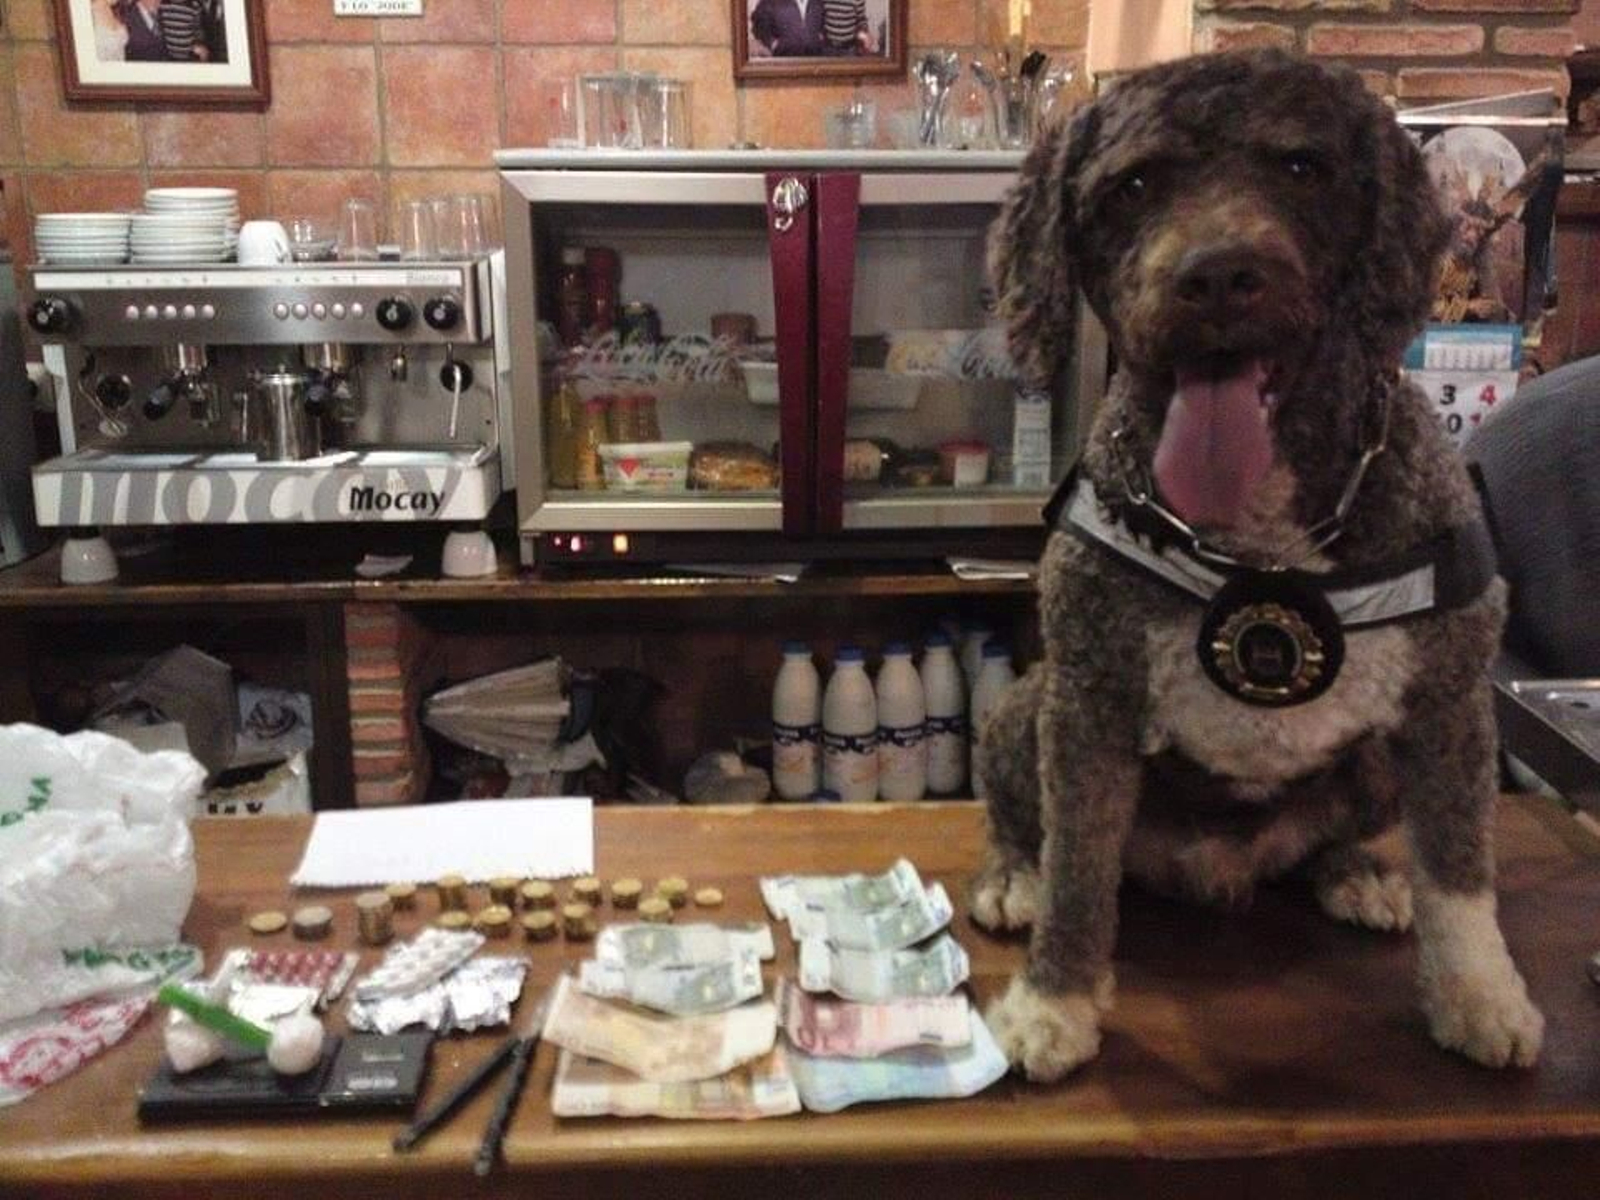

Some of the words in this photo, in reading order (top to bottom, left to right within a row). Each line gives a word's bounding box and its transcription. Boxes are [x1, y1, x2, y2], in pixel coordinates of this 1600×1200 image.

[1439, 385, 1456, 405] 3
[1480, 385, 1496, 406] 4
[350, 487, 445, 516] Mocay
